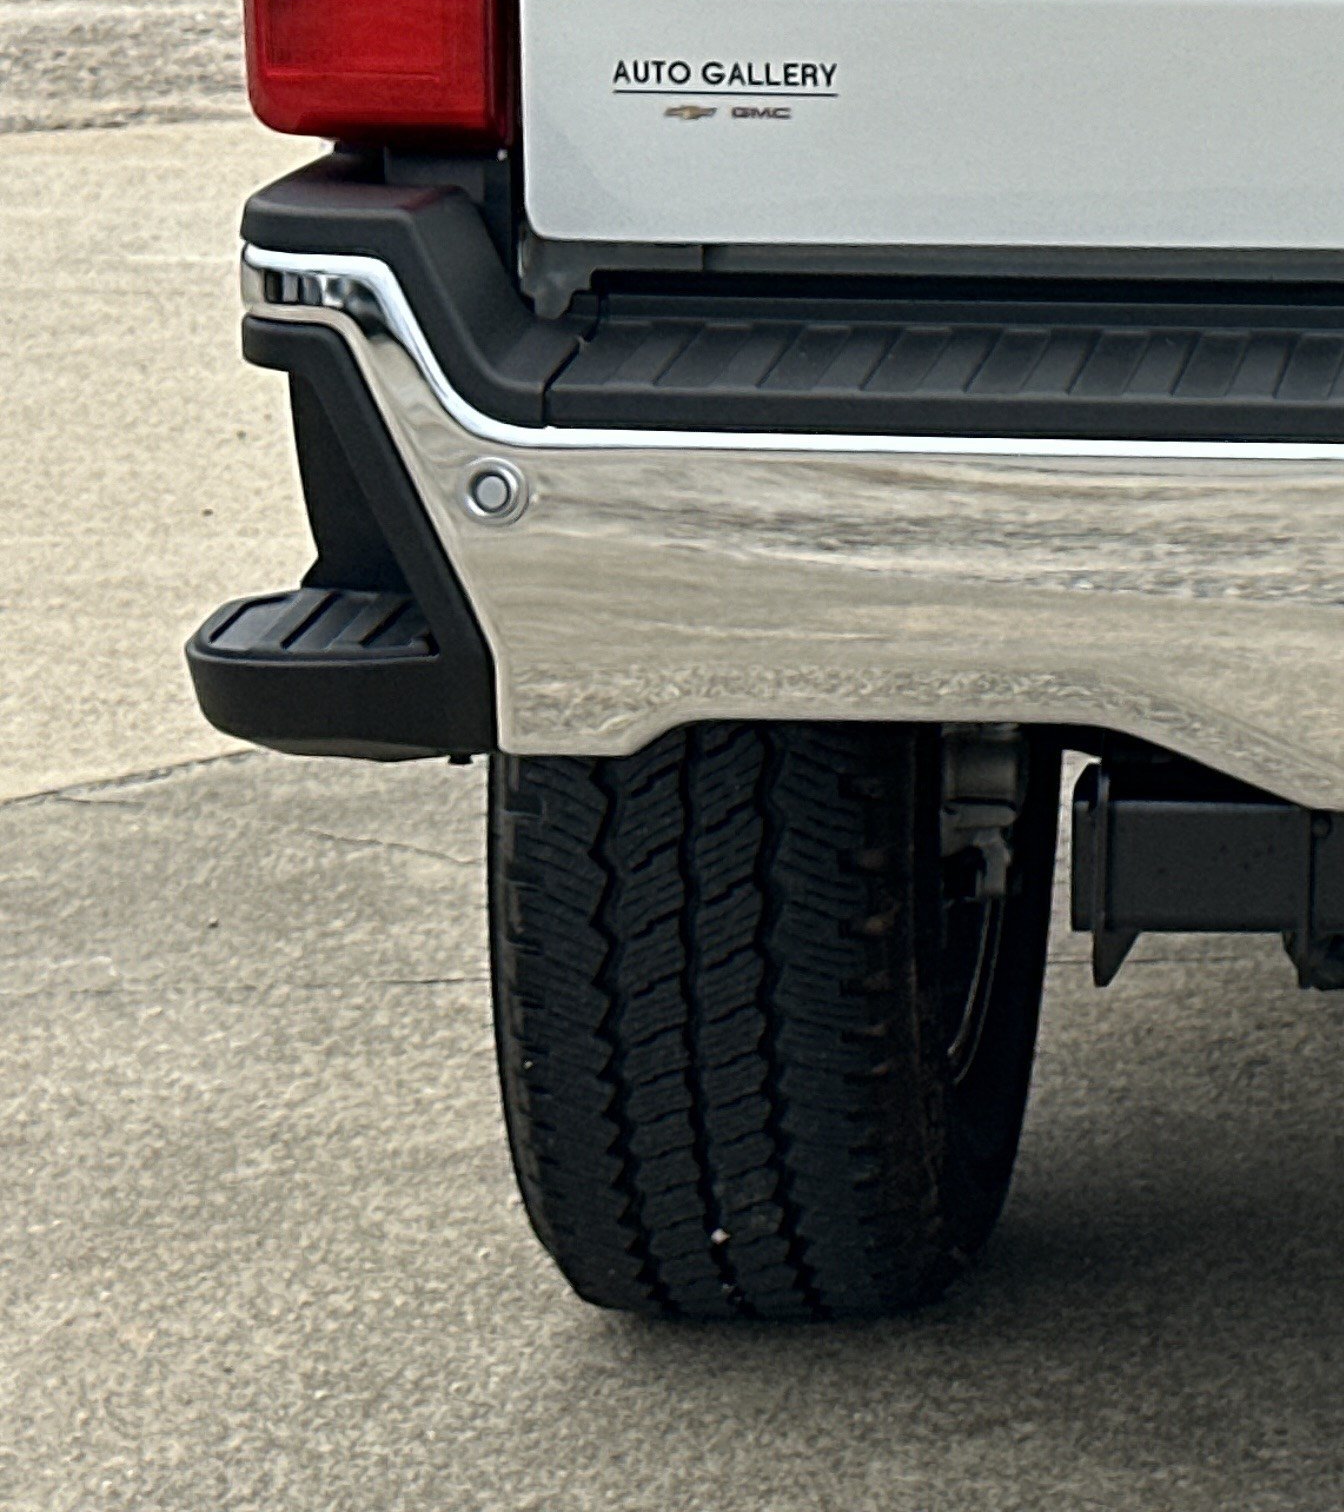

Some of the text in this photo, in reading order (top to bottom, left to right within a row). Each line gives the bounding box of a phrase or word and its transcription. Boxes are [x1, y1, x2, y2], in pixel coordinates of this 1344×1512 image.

[612, 58, 838, 88] AUTO GALLERY
[730, 106, 792, 120] GMC
